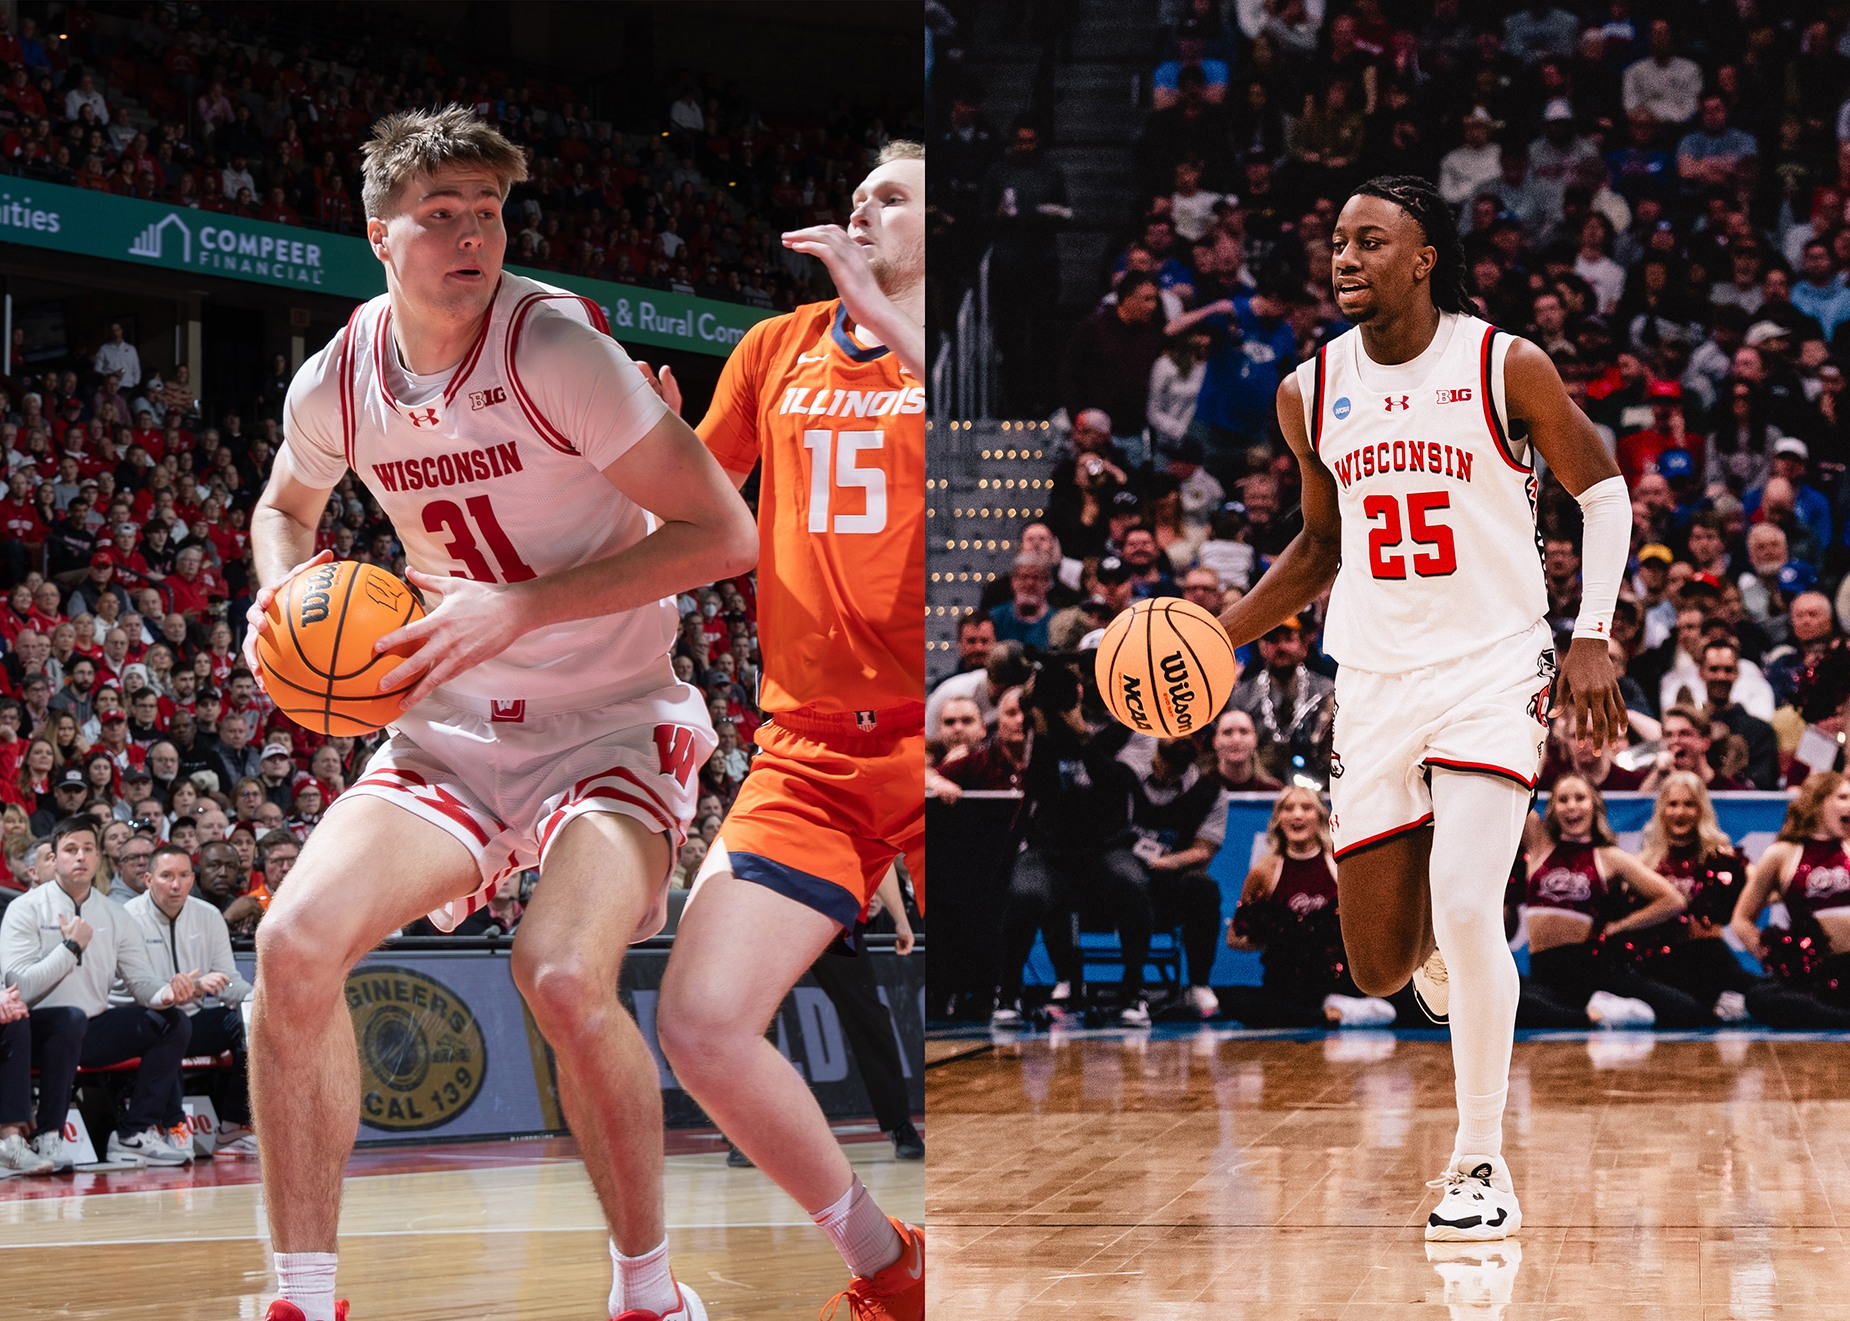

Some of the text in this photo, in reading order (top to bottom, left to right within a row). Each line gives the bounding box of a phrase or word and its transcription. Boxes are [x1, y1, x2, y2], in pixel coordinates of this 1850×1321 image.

[0, 193, 61, 233] ities
[199, 251, 323, 285] FINANCIAL
[200, 226, 322, 268] COMPEER
[616, 298, 634, 327] &
[640, 301, 693, 337] Rural
[779, 387, 925, 418] ILLINOIS
[372, 440, 523, 493] WISCONSIN
[803, 429, 887, 534] 15
[1334, 440, 1473, 489] WISCONSIN
[421, 494, 538, 584] 31
[1363, 490, 1458, 580] 25
[1123, 674, 1154, 730] NCAA
[1160, 650, 1195, 734] Wilson
[652, 724, 696, 790] W
[431, 1066, 473, 1112] 139
